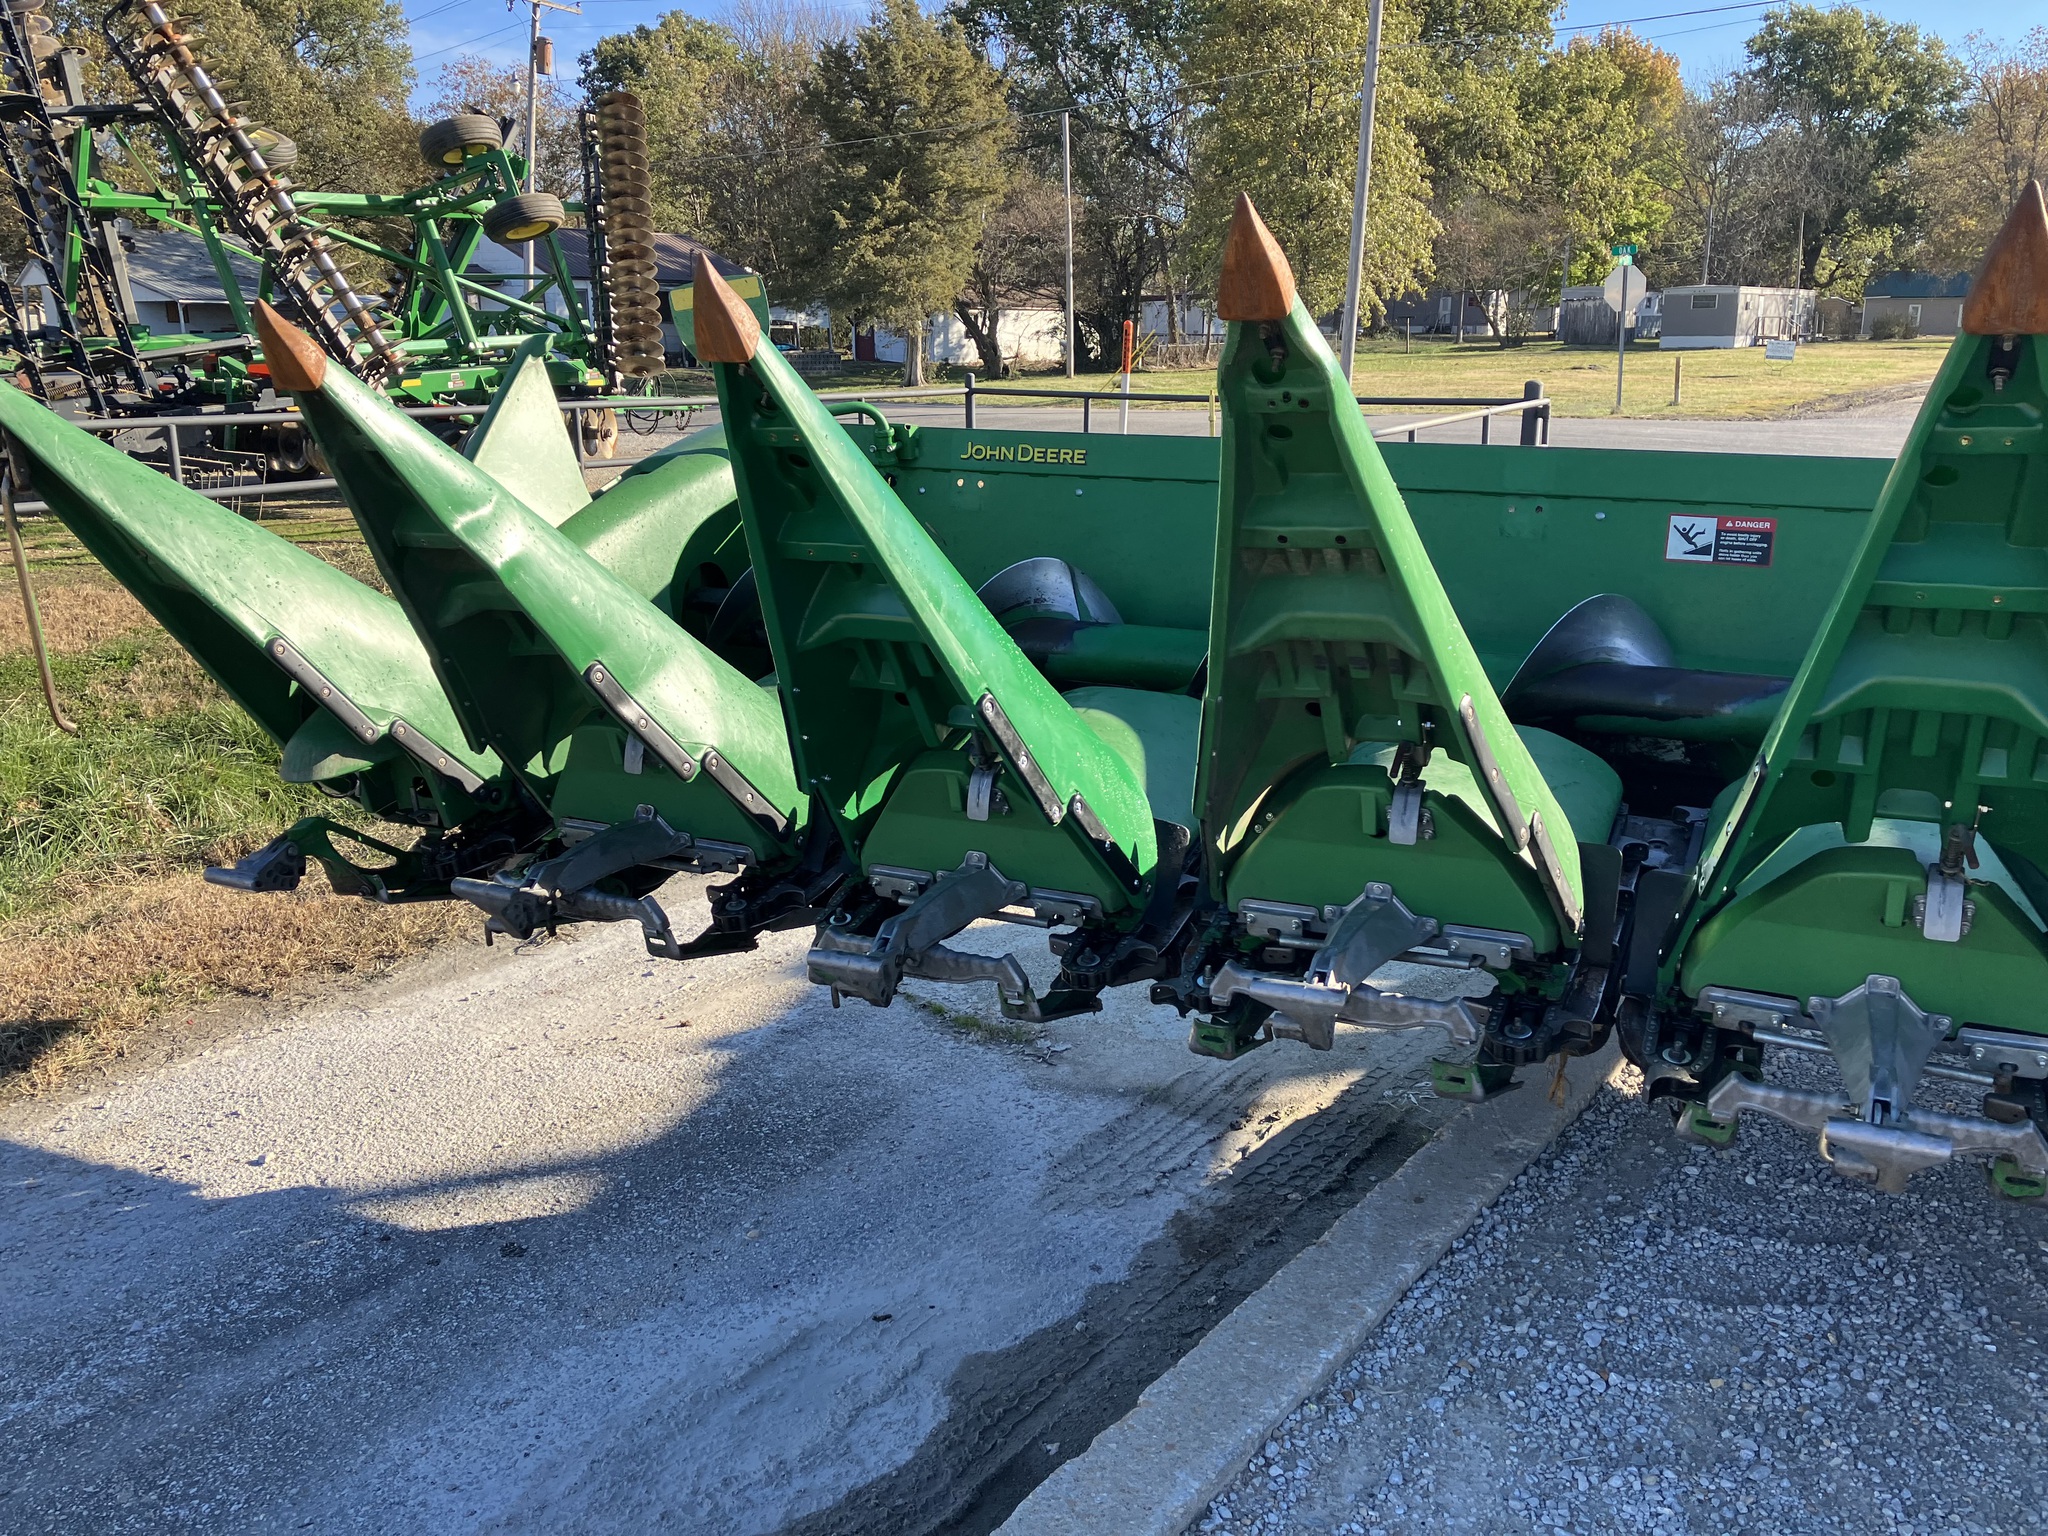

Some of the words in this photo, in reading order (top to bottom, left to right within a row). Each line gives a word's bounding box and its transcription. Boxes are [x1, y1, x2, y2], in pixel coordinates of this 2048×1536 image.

[960, 441, 1014, 461] JOHN
[1017, 444, 1087, 464] DEERE
[1735, 520, 1771, 529] DANGER
